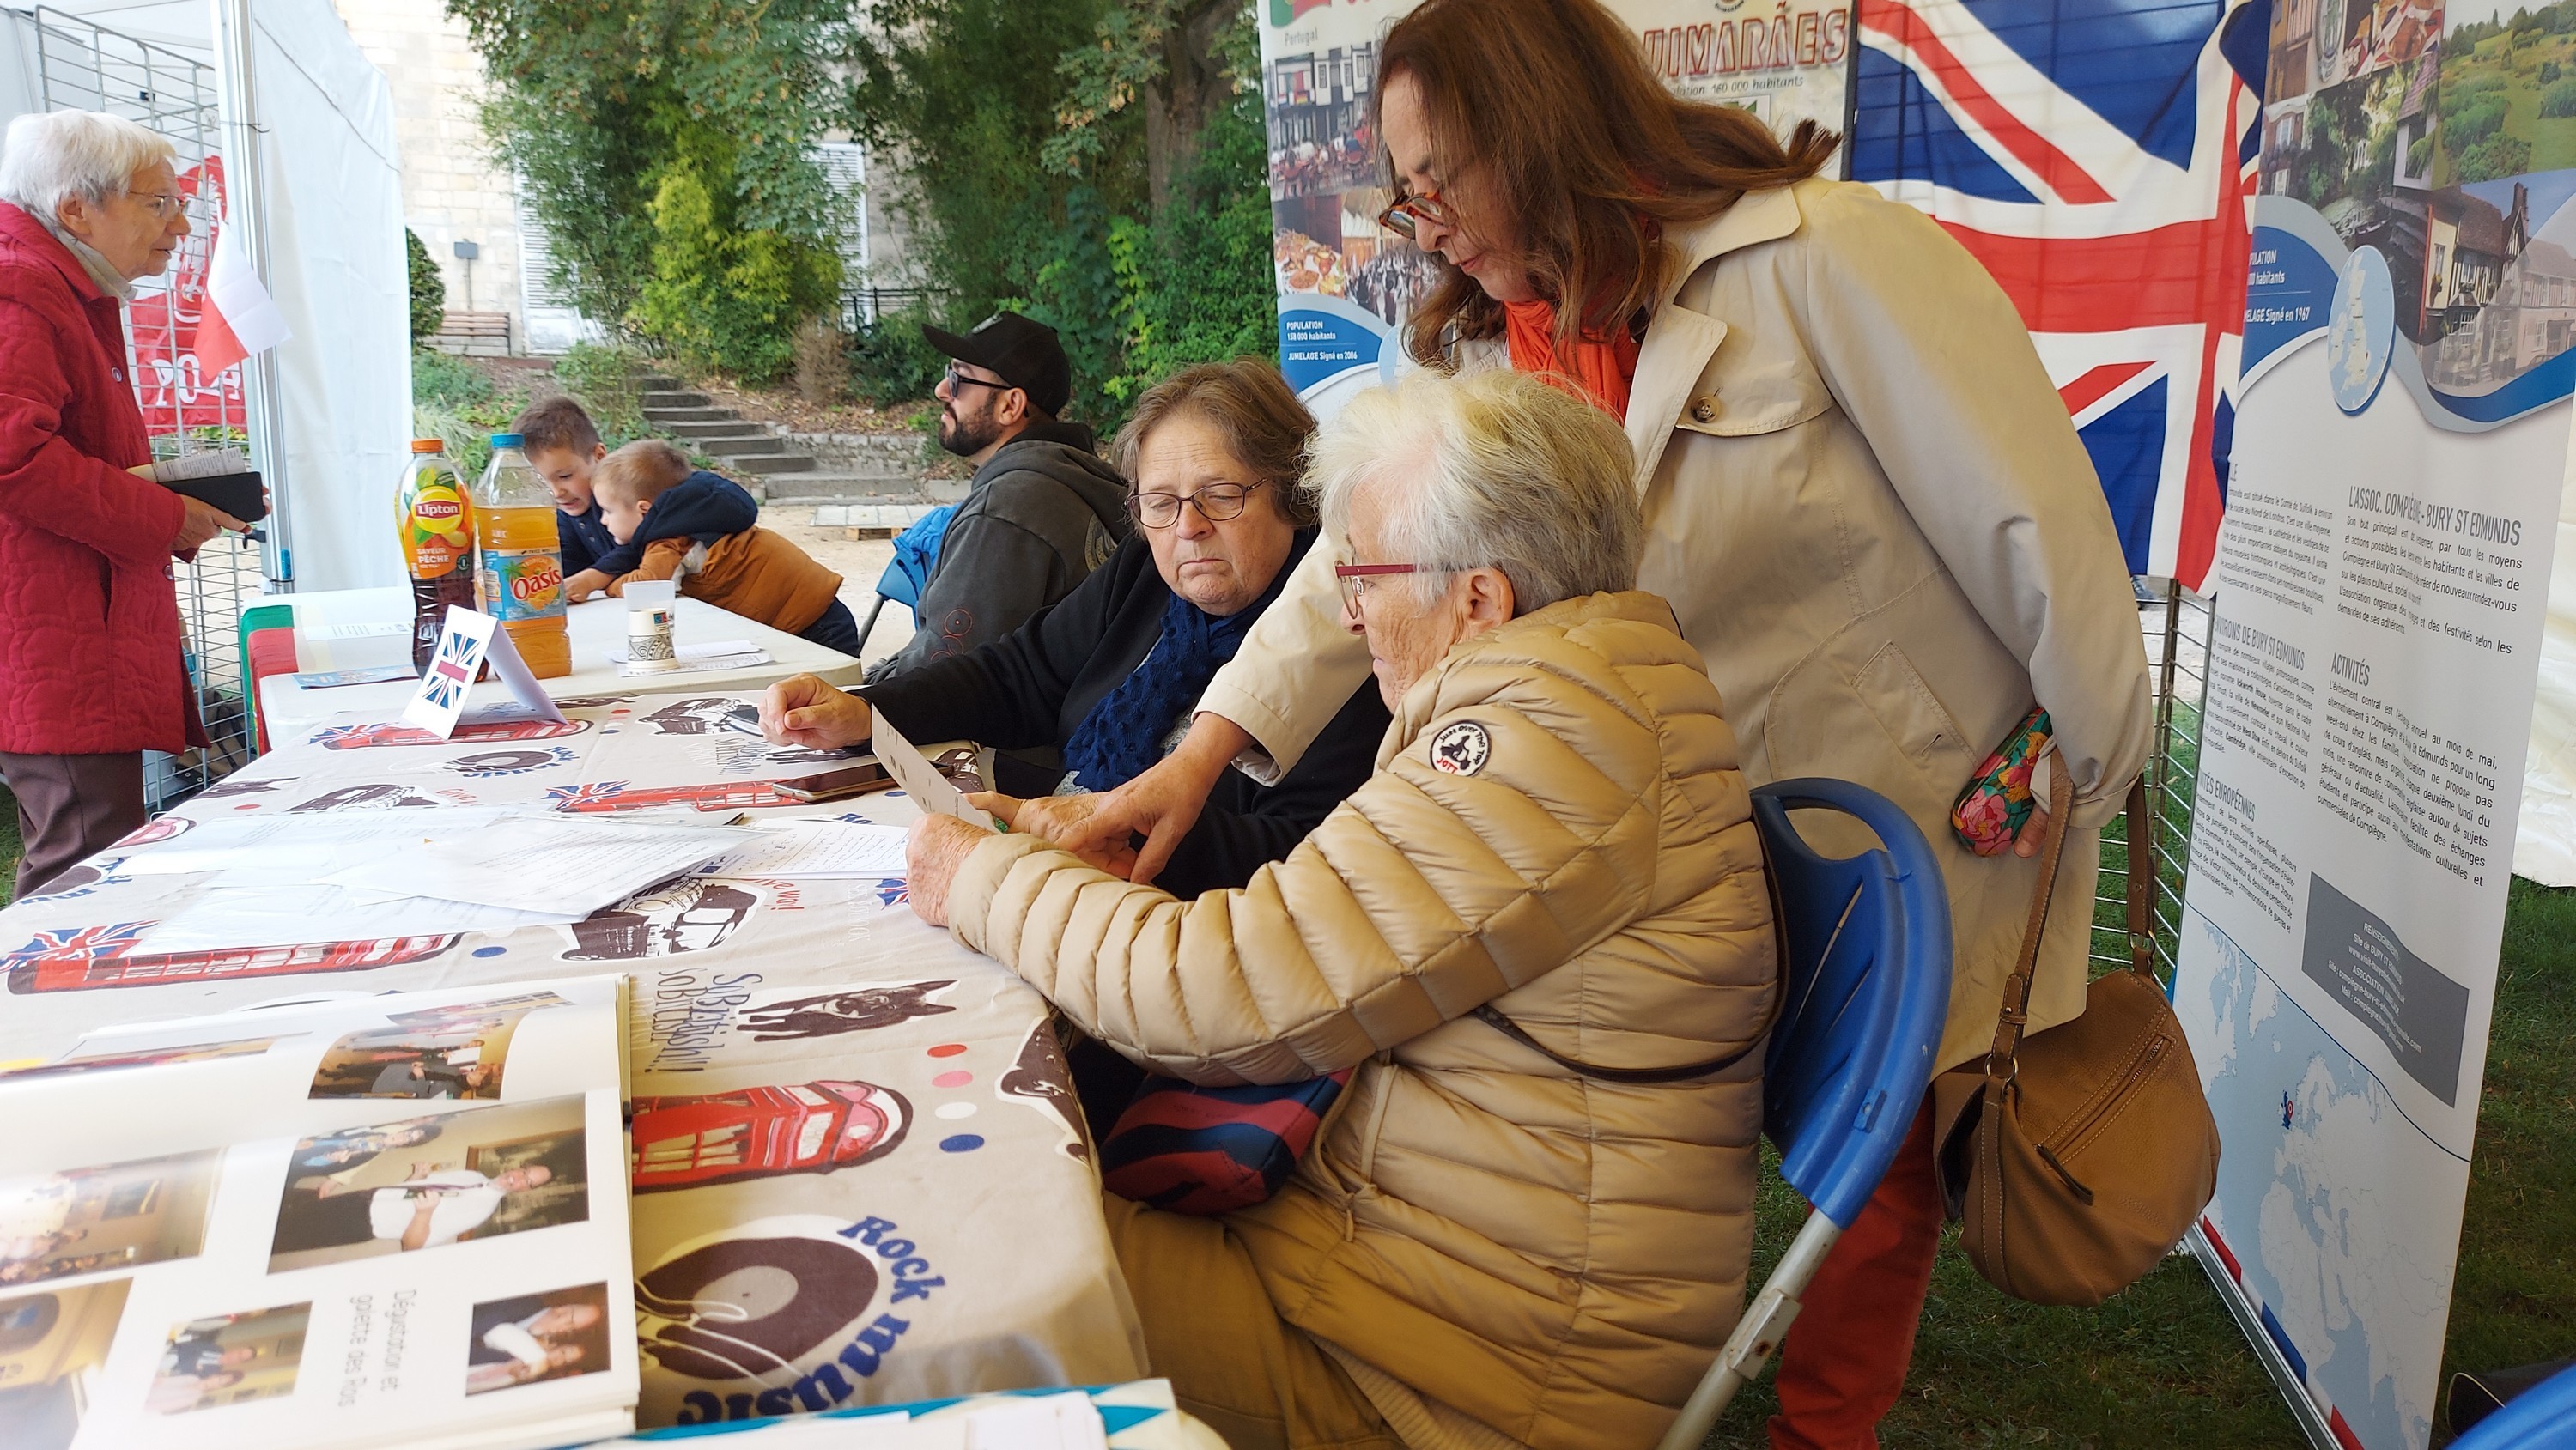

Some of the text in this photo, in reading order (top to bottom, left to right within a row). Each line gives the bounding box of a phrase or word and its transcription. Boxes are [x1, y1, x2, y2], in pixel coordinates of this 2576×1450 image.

[1285, 27, 1318, 46] Portugal
[1642, 1, 1846, 77] UIMARÃES
[1753, 76, 1803, 90] habitants
[2249, 250, 2277, 266] PULATION
[2256, 270, 2285, 285] habitants
[1286, 321, 1323, 330] POPULATION
[1309, 331, 1336, 340] habitants
[2265, 306, 2310, 325] Signé en 1967
[1288, 351, 1318, 361] JUMELAGE
[1320, 350, 1335, 361] Signé
[1344, 350, 1358, 360] 2006
[417, 505, 459, 517] Lipton
[2349, 486, 2382, 513] L'ASSOC.
[2426, 503, 2453, 531] BURY
[2455, 509, 2469, 535] ST
[2470, 512, 2521, 546] EDMUNDS
[418, 554, 450, 563] PÊCHE
[2347, 515, 2356, 526] Son
[2372, 521, 2397, 537] principal
[2439, 542, 2451, 554] par
[2458, 544, 2471, 558] tous
[2488, 555, 2522, 569] moyens
[2341, 570, 2349, 579] sur
[2357, 573, 2371, 586] plans
[2342, 551, 2517, 612] Compiègne et Bury St de nouveaux rendez-vous
[2351, 537, 2369, 549] actions
[2433, 559, 2465, 577] habitants
[2467, 569, 2474, 579] et
[2485, 573, 2503, 588] villes
[2506, 578, 2520, 591] de
[2337, 602, 2380, 625] demandes de ses
[2373, 598, 2397, 612] organise
[2428, 619, 2440, 632] des
[2444, 622, 2472, 643] festivités
[2476, 634, 2493, 650] selon
[2497, 640, 2512, 654] les
[2242, 625, 2305, 670] DE BURY ST EDMUNDS
[2330, 652, 2370, 687] ACTIVITÉS
[1474, 731, 1485, 748] The
[2361, 696, 2382, 710] central
[2385, 705, 2393, 716] est
[2432, 734, 2441, 745] au
[2446, 740, 2462, 754] mois
[2465, 748, 2474, 760] de
[2478, 755, 2497, 770] mai,
[2371, 715, 2399, 737] Compiègne
[2418, 745, 2449, 768] Edmunds
[2450, 761, 2464, 775] pour
[2465, 769, 2474, 780] un
[2476, 771, 2495, 791] long
[1437, 757, 1458, 774] JOTT
[1473, 750, 1485, 766] Top
[2324, 729, 2330, 740] de
[2332, 735, 2346, 748] cours
[2348, 741, 2372, 762] d'anglais,
[2375, 755, 2388, 769] mais
[2423, 787, 2455, 811] deuxième
[2458, 803, 2473, 822] lundi
[2477, 814, 2491, 828] du
[2326, 714, 2348, 731] week-end
[2352, 725, 2365, 739] chez
[2431, 773, 2440, 784] ne
[2445, 780, 2470, 799] propose
[2476, 794, 2494, 809] pas
[2215, 780, 2256, 822] EUROPÉENNES
[2318, 795, 2387, 842] commerciales de Compiègne.
[2321, 762, 2342, 780] généraux
[2344, 776, 2352, 786] ou
[2409, 817, 2428, 839] facilite
[2433, 832, 2446, 847] des
[2451, 840, 2486, 867] échanges
[2336, 754, 2346, 765] une
[2348, 761, 2372, 779] rencontre
[2374, 772, 2382, 784] de
[2406, 798, 2426, 817] anglaise
[2428, 811, 2451, 829] autour
[2452, 822, 2461, 835] de
[2463, 829, 2488, 847] sujets
[2342, 792, 2348, 803] et
[2350, 798, 2374, 816] participe
[2377, 811, 2391, 825] aussi
[2435, 855, 2469, 881] culturelles
[2474, 876, 2484, 887] et
[2353, 933, 2363, 946] Site
[2363, 941, 2370, 951] de
[2370, 944, 2384, 962] BURY
[2353, 965, 2385, 996] ASSOCIATION
[837, 1215, 946, 1304] Rock
[337, 1295, 375, 1408] galette des Rois
[380, 1289, 417, 1392] Dégustation et
[676, 1313, 910, 1427] music
